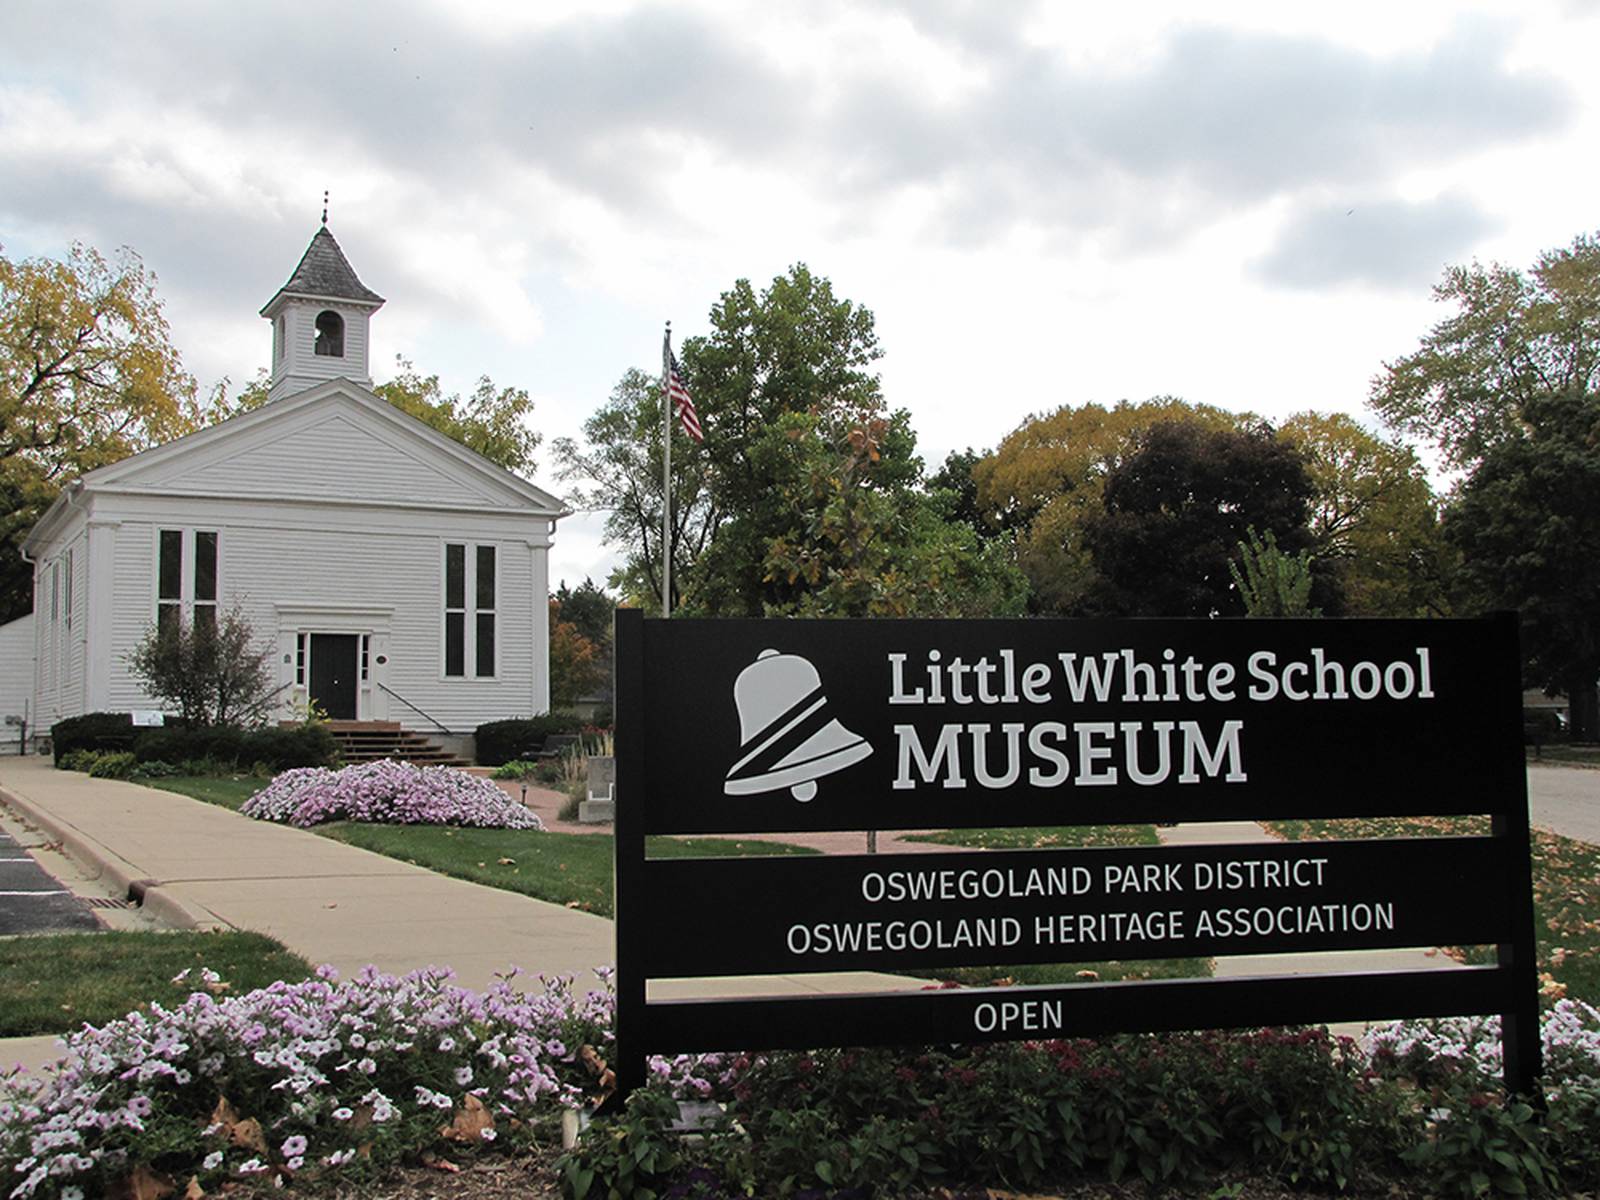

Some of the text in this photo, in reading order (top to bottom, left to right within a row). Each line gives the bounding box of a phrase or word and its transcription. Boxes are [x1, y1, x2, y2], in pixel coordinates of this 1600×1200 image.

[887, 647, 1435, 705] Little White School
[891, 720, 1248, 790] MUSEUM
[862, 858, 1328, 902] OSWEGOLAND PARK DISTRICT
[787, 902, 1394, 954] OSWEGOLAND HERITAGE ASSOCIATION
[973, 1000, 1062, 1032] OPEN
